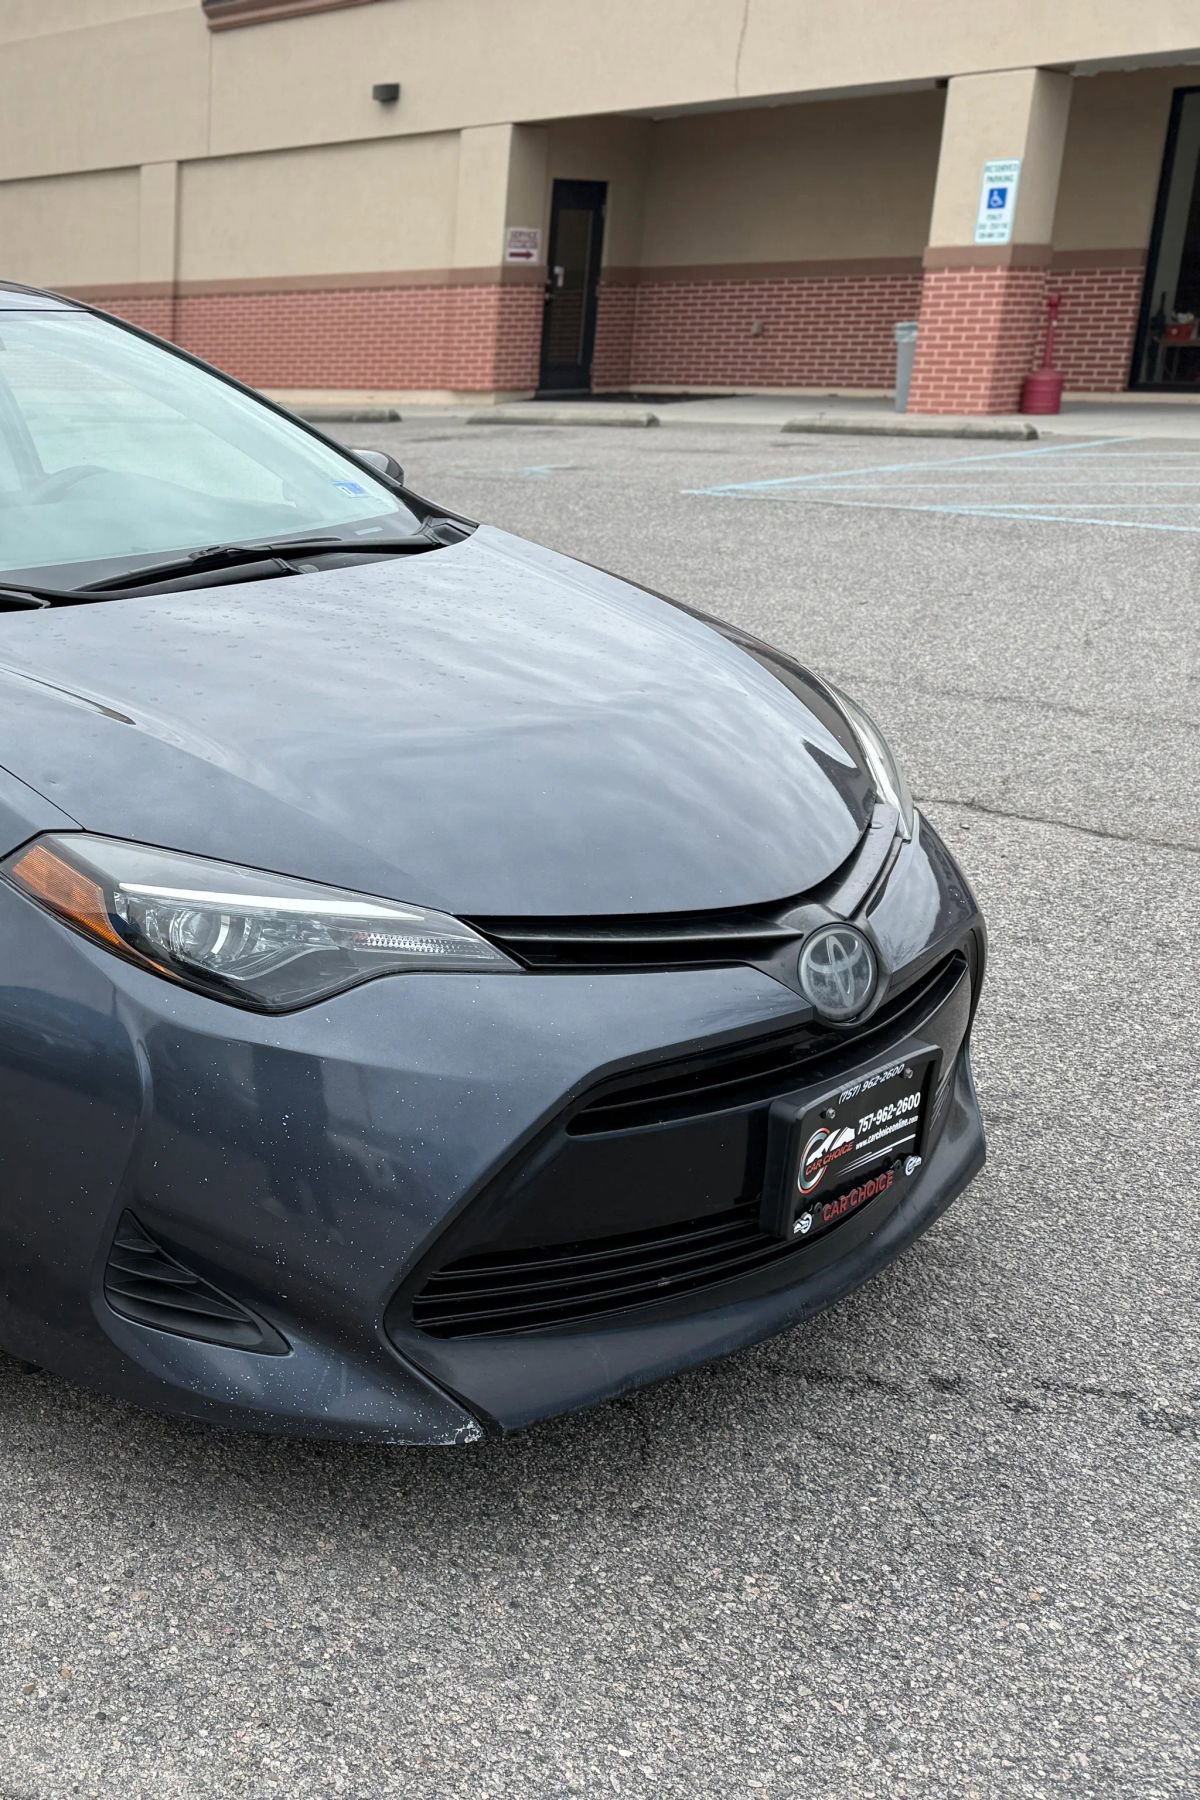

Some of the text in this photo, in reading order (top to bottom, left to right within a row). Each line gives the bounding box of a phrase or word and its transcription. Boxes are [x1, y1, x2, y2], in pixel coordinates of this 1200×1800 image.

[861, 1064, 905, 1093] 962-2600
[857, 1091, 921, 1135] 757-962-2600
[855, 1115, 919, 1150] www.carchoiceonline.com
[805, 1141, 854, 1176] CAR CHOICE
[822, 1170, 895, 1222] CAR CHOICE
